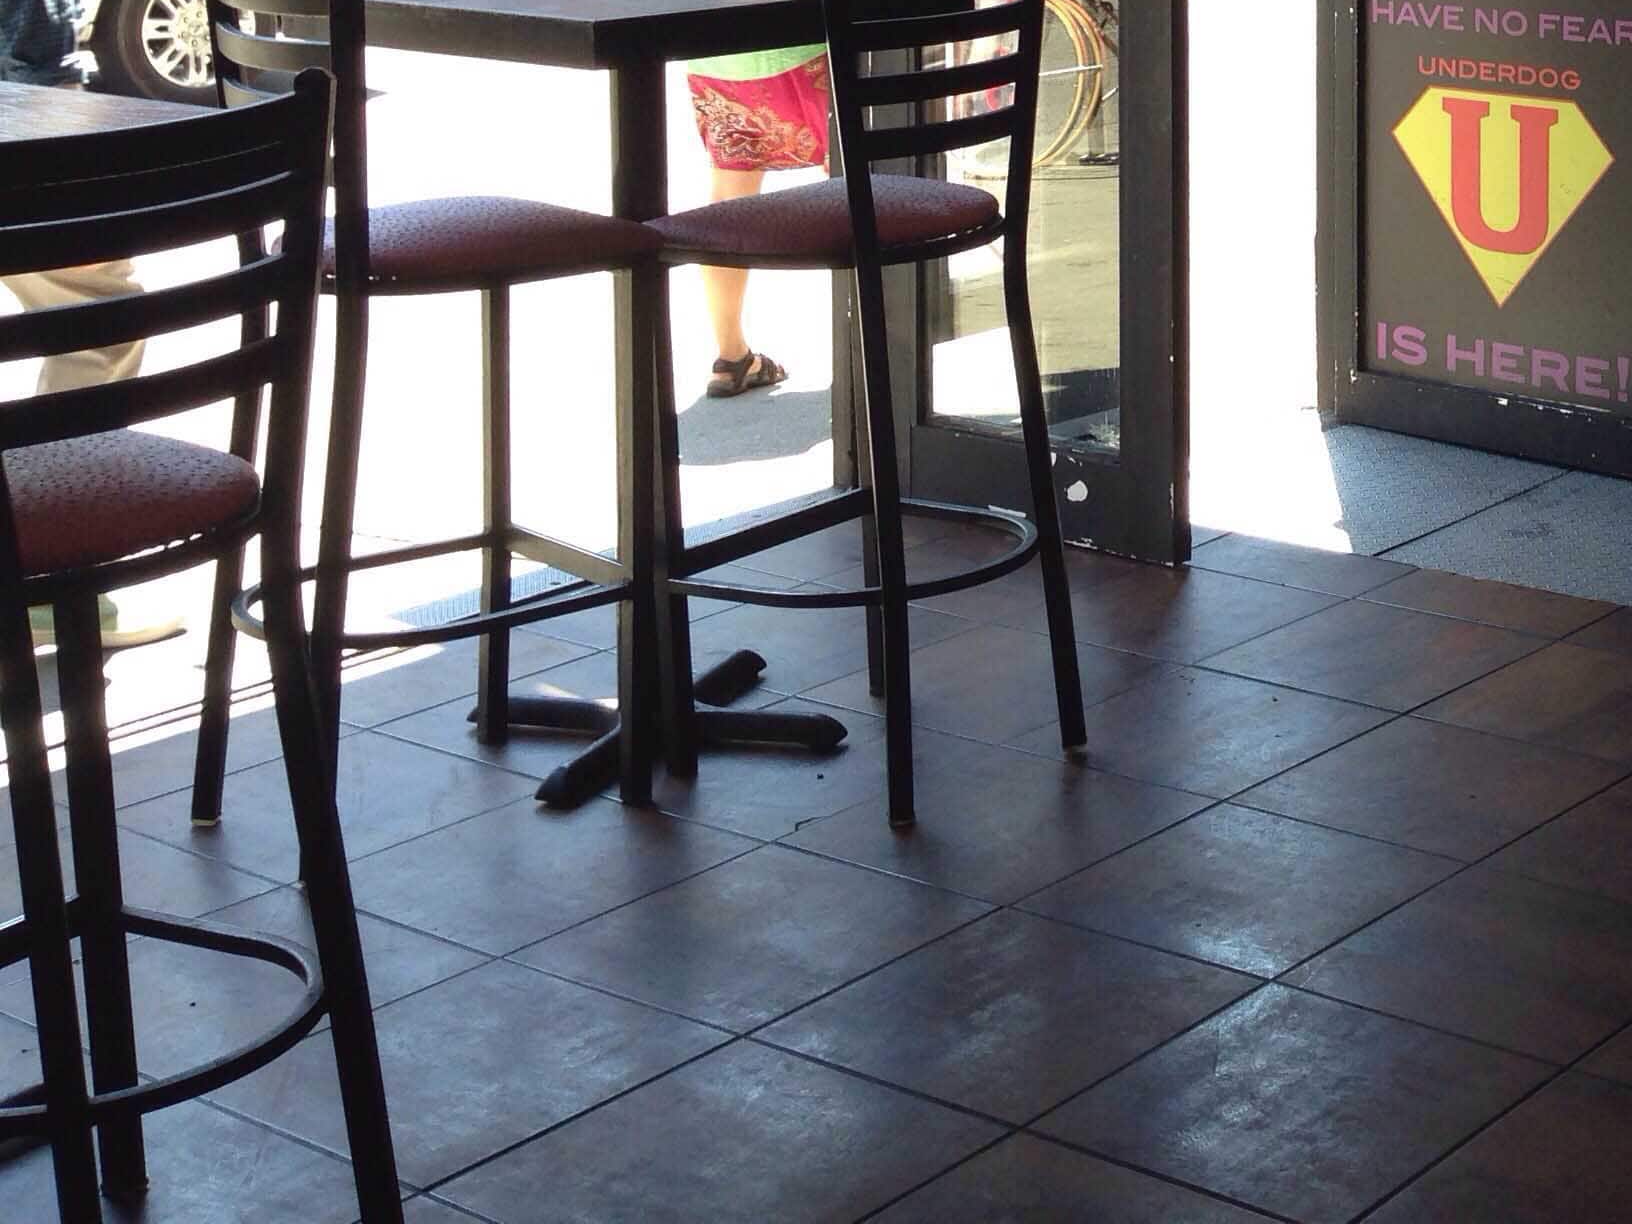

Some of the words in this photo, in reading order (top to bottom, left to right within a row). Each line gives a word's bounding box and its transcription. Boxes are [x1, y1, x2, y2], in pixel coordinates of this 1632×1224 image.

[1372, 0, 1465, 32] HAVE
[1474, 7, 1528, 37] NO
[1418, 55, 1582, 90] UNDERDOG
[1442, 96, 1559, 255] U
[1376, 321, 1428, 366] IS
[1445, 333, 1632, 403] HERE!
